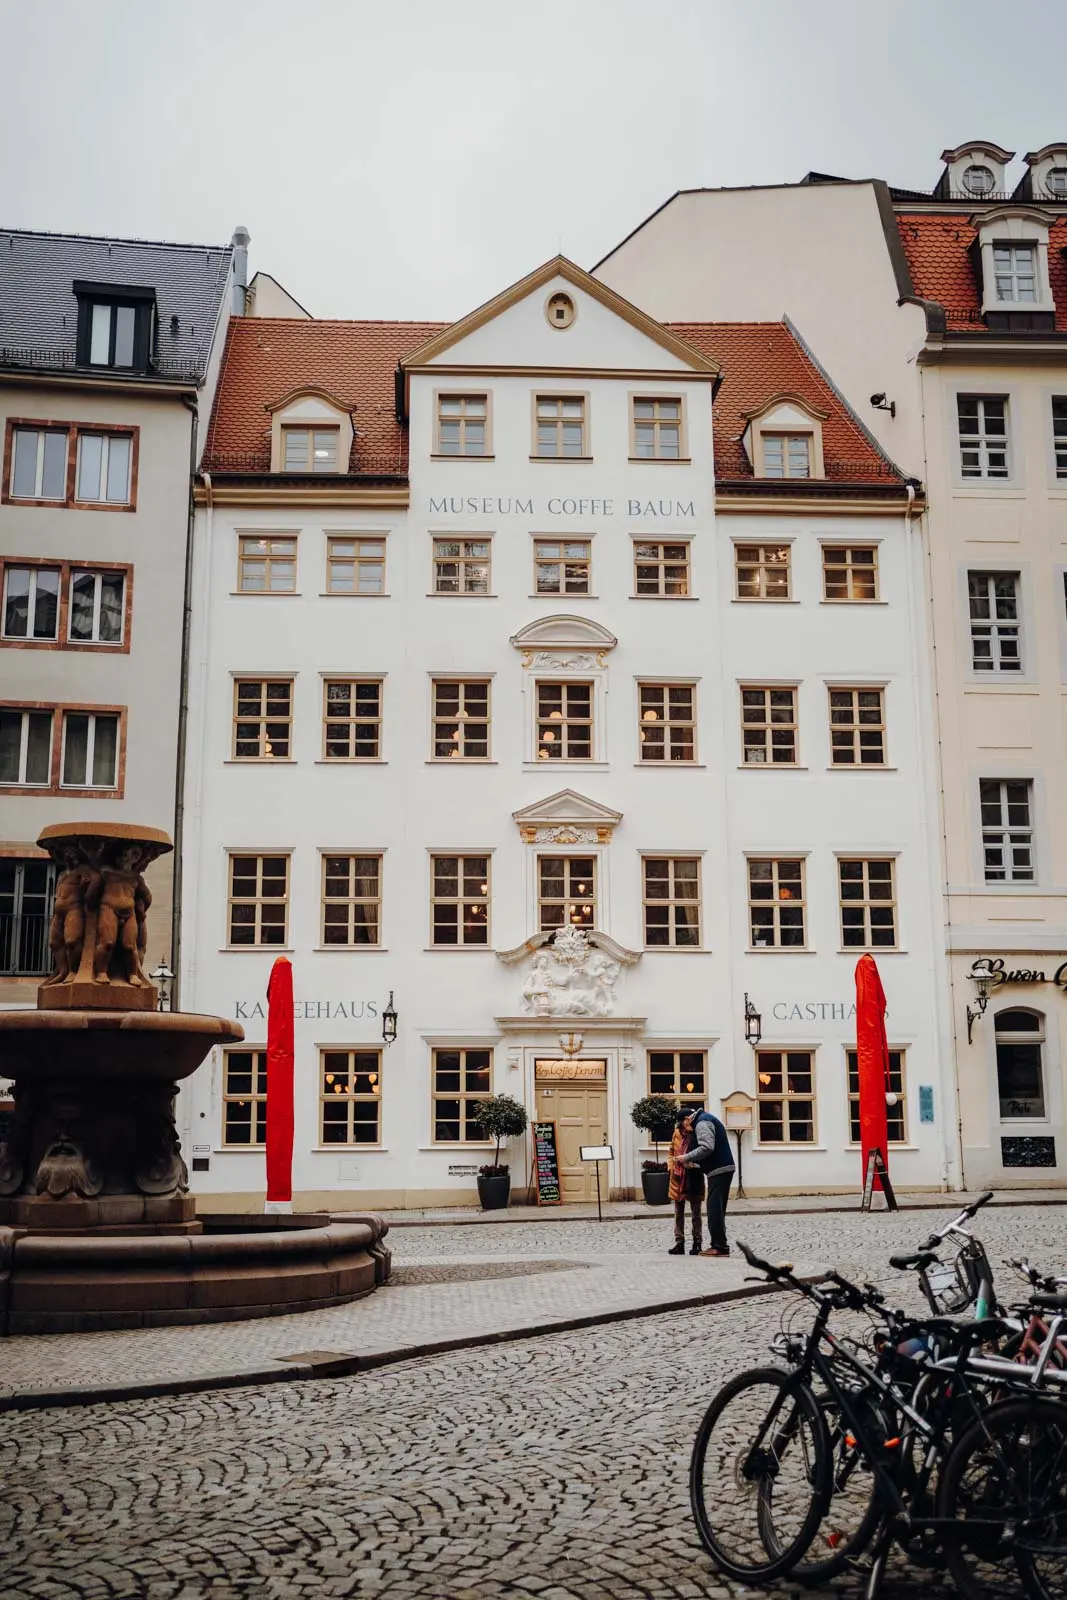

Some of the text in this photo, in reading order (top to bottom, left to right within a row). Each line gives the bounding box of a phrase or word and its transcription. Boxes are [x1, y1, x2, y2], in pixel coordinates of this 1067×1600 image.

[428, 497, 696, 518] MUSEUM COFFE BAUM
[234, 1000, 378, 1019] KAEEHAUS
